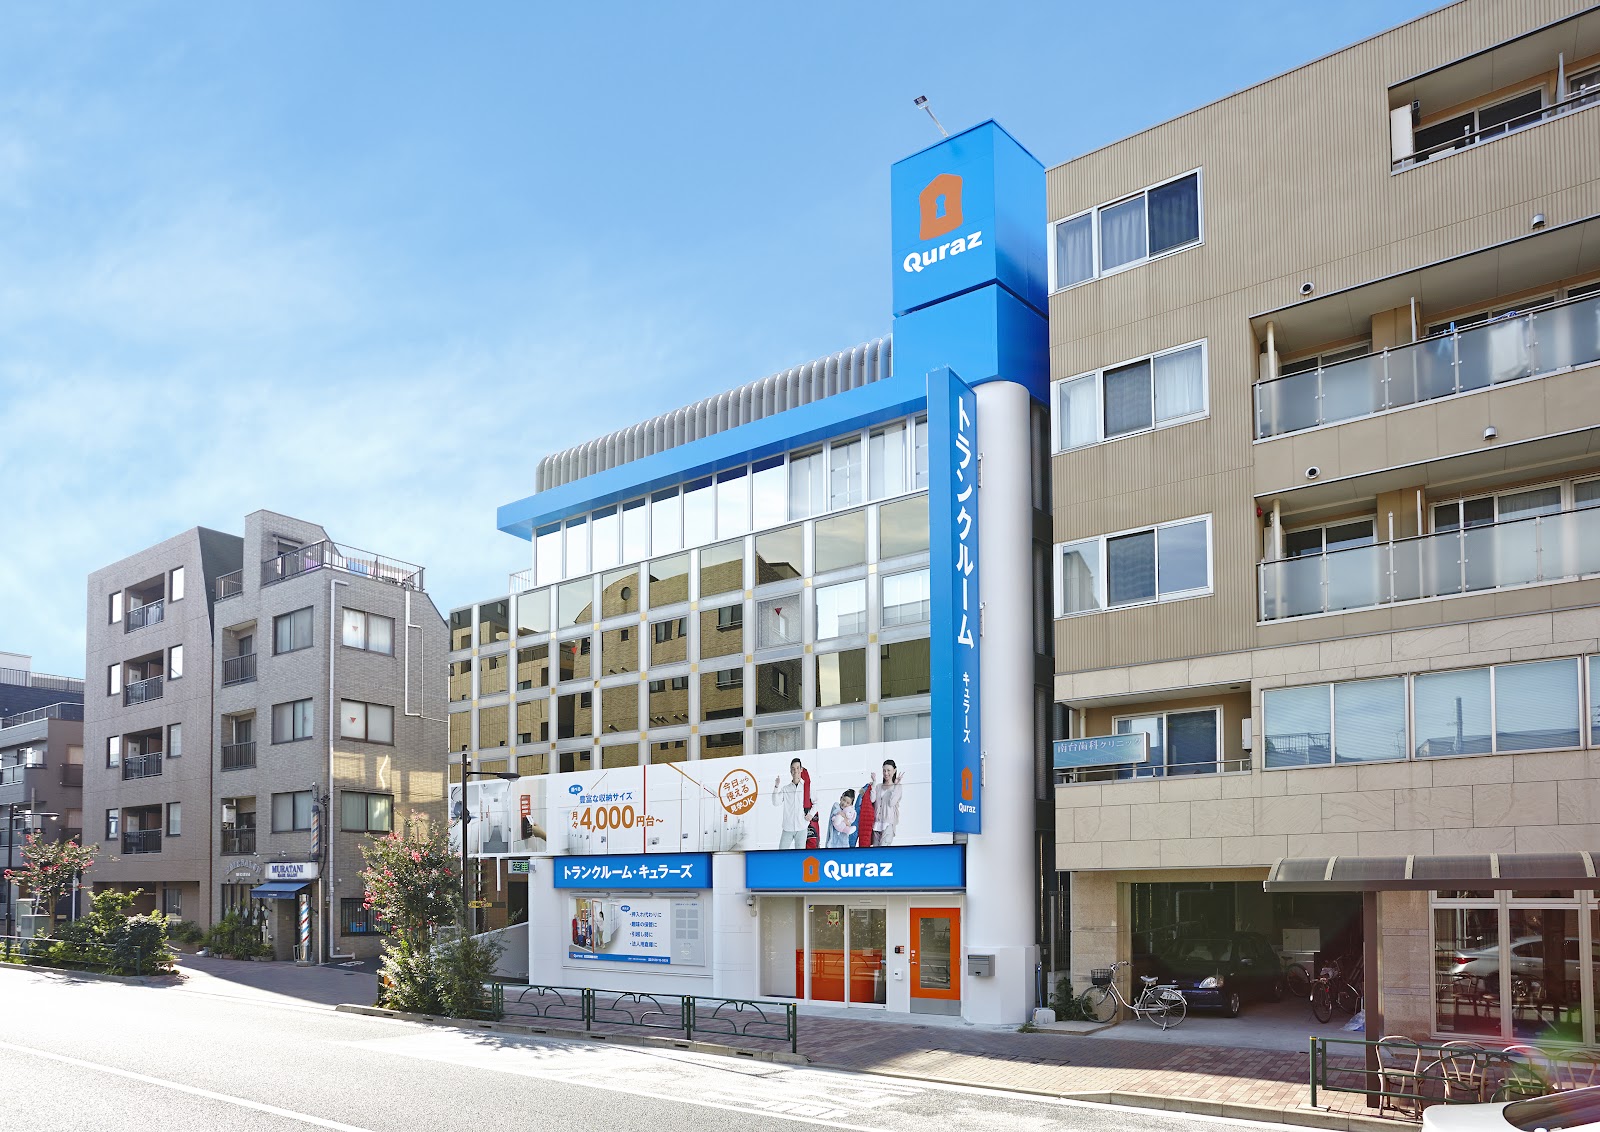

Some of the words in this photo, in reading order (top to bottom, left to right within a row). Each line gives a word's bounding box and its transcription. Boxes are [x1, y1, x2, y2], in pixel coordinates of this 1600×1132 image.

[903, 231, 983, 273] Quraz
[955, 395, 974, 650] トランクルーム
[962, 672, 971, 743] キュラーズ
[1057, 739, 1142, 753] 南台歯科クリニック
[723, 776, 749, 791] 今日から
[579, 792, 633, 804] 豊富な収納サイズ
[726, 784, 749, 802] 使える
[958, 802, 976, 814] Quraz
[271, 864, 304, 873] MURATANI
[512, 861, 529, 873] 空車
[564, 863, 694, 880] トランクルーム・キュラーズ
[823, 860, 894, 881] Quraz
